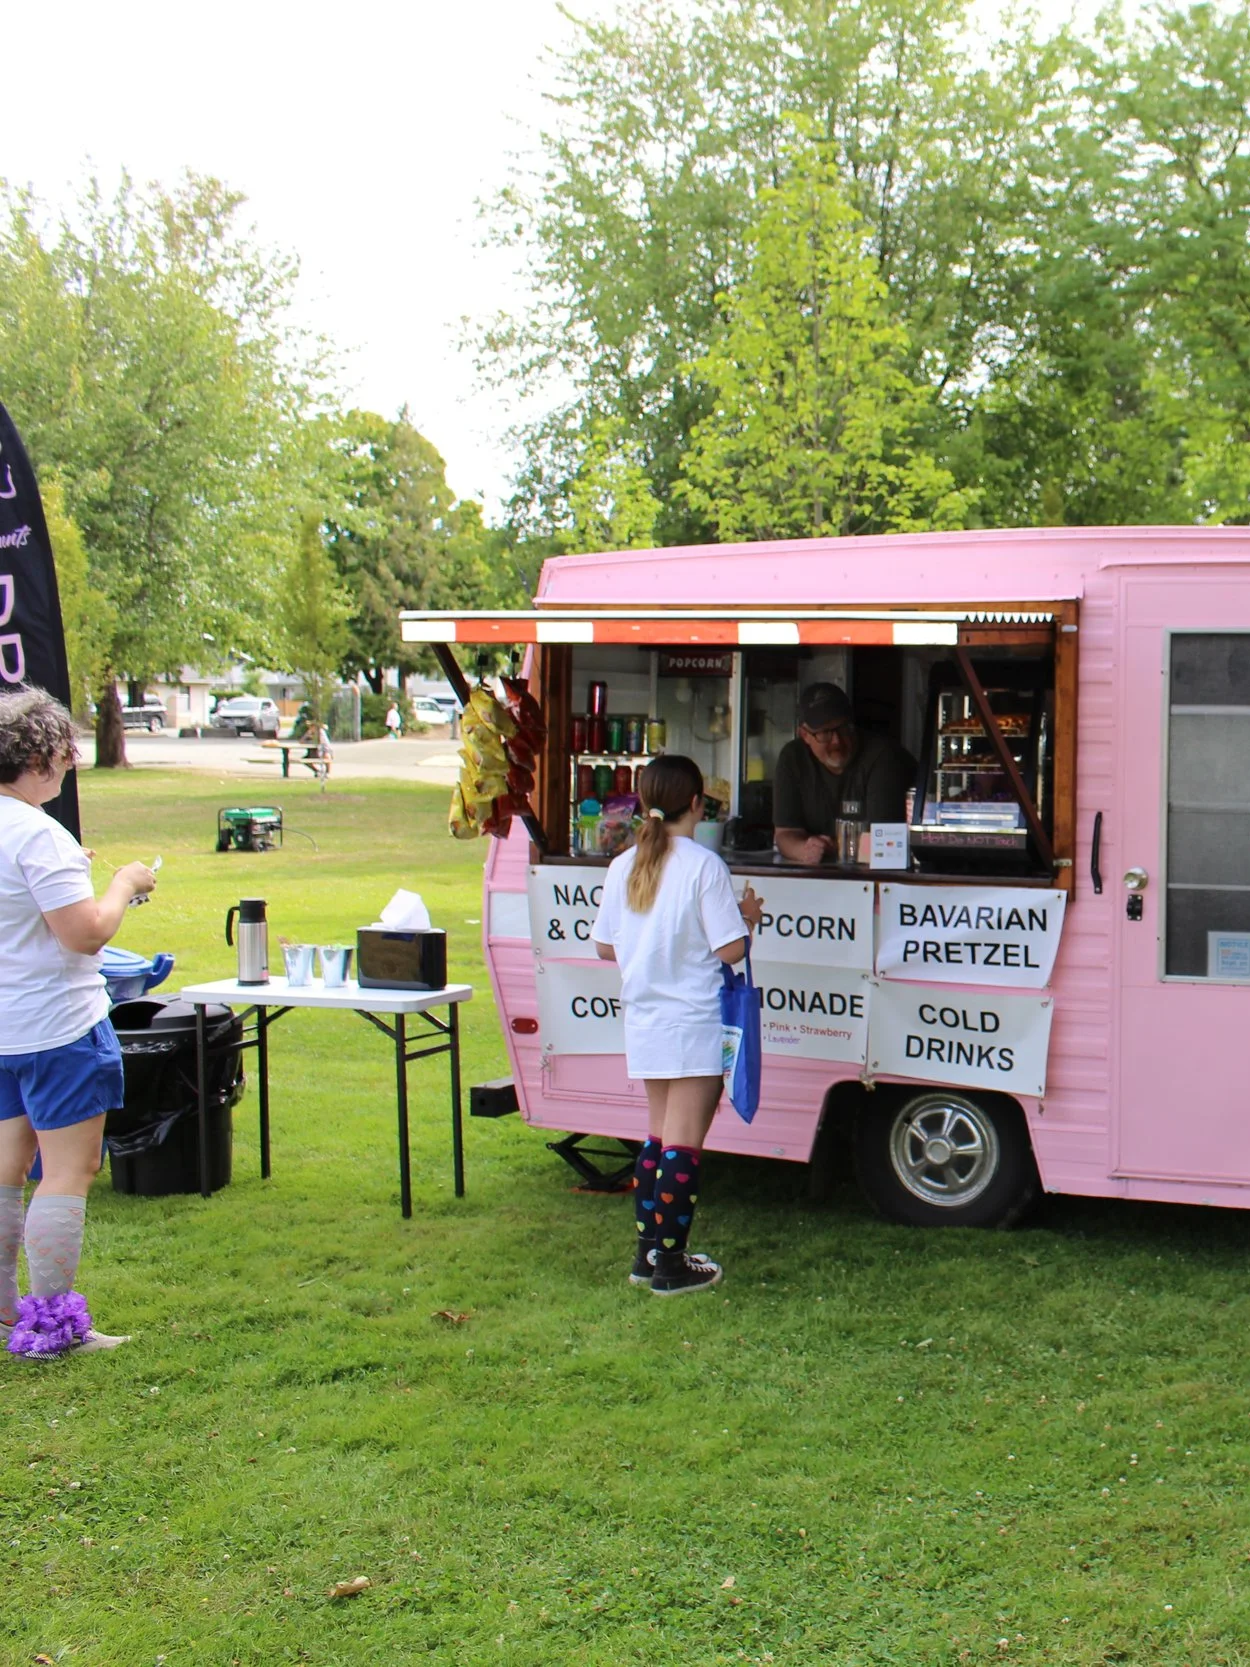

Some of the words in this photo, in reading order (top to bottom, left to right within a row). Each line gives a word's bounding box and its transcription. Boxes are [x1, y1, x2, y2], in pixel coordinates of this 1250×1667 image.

[668, 656, 723, 669] POPCORN
[899, 903, 1048, 932] BAVARIAN
[547, 918, 566, 941] &
[902, 940, 1040, 968] PRETZEL
[769, 1022, 790, 1032] Pink
[918, 1003, 1001, 1034] COLD
[767, 1034, 801, 1044] Lavender
[800, 1024, 853, 1041] Strawberry
[906, 1034, 1015, 1072] DRINKS
